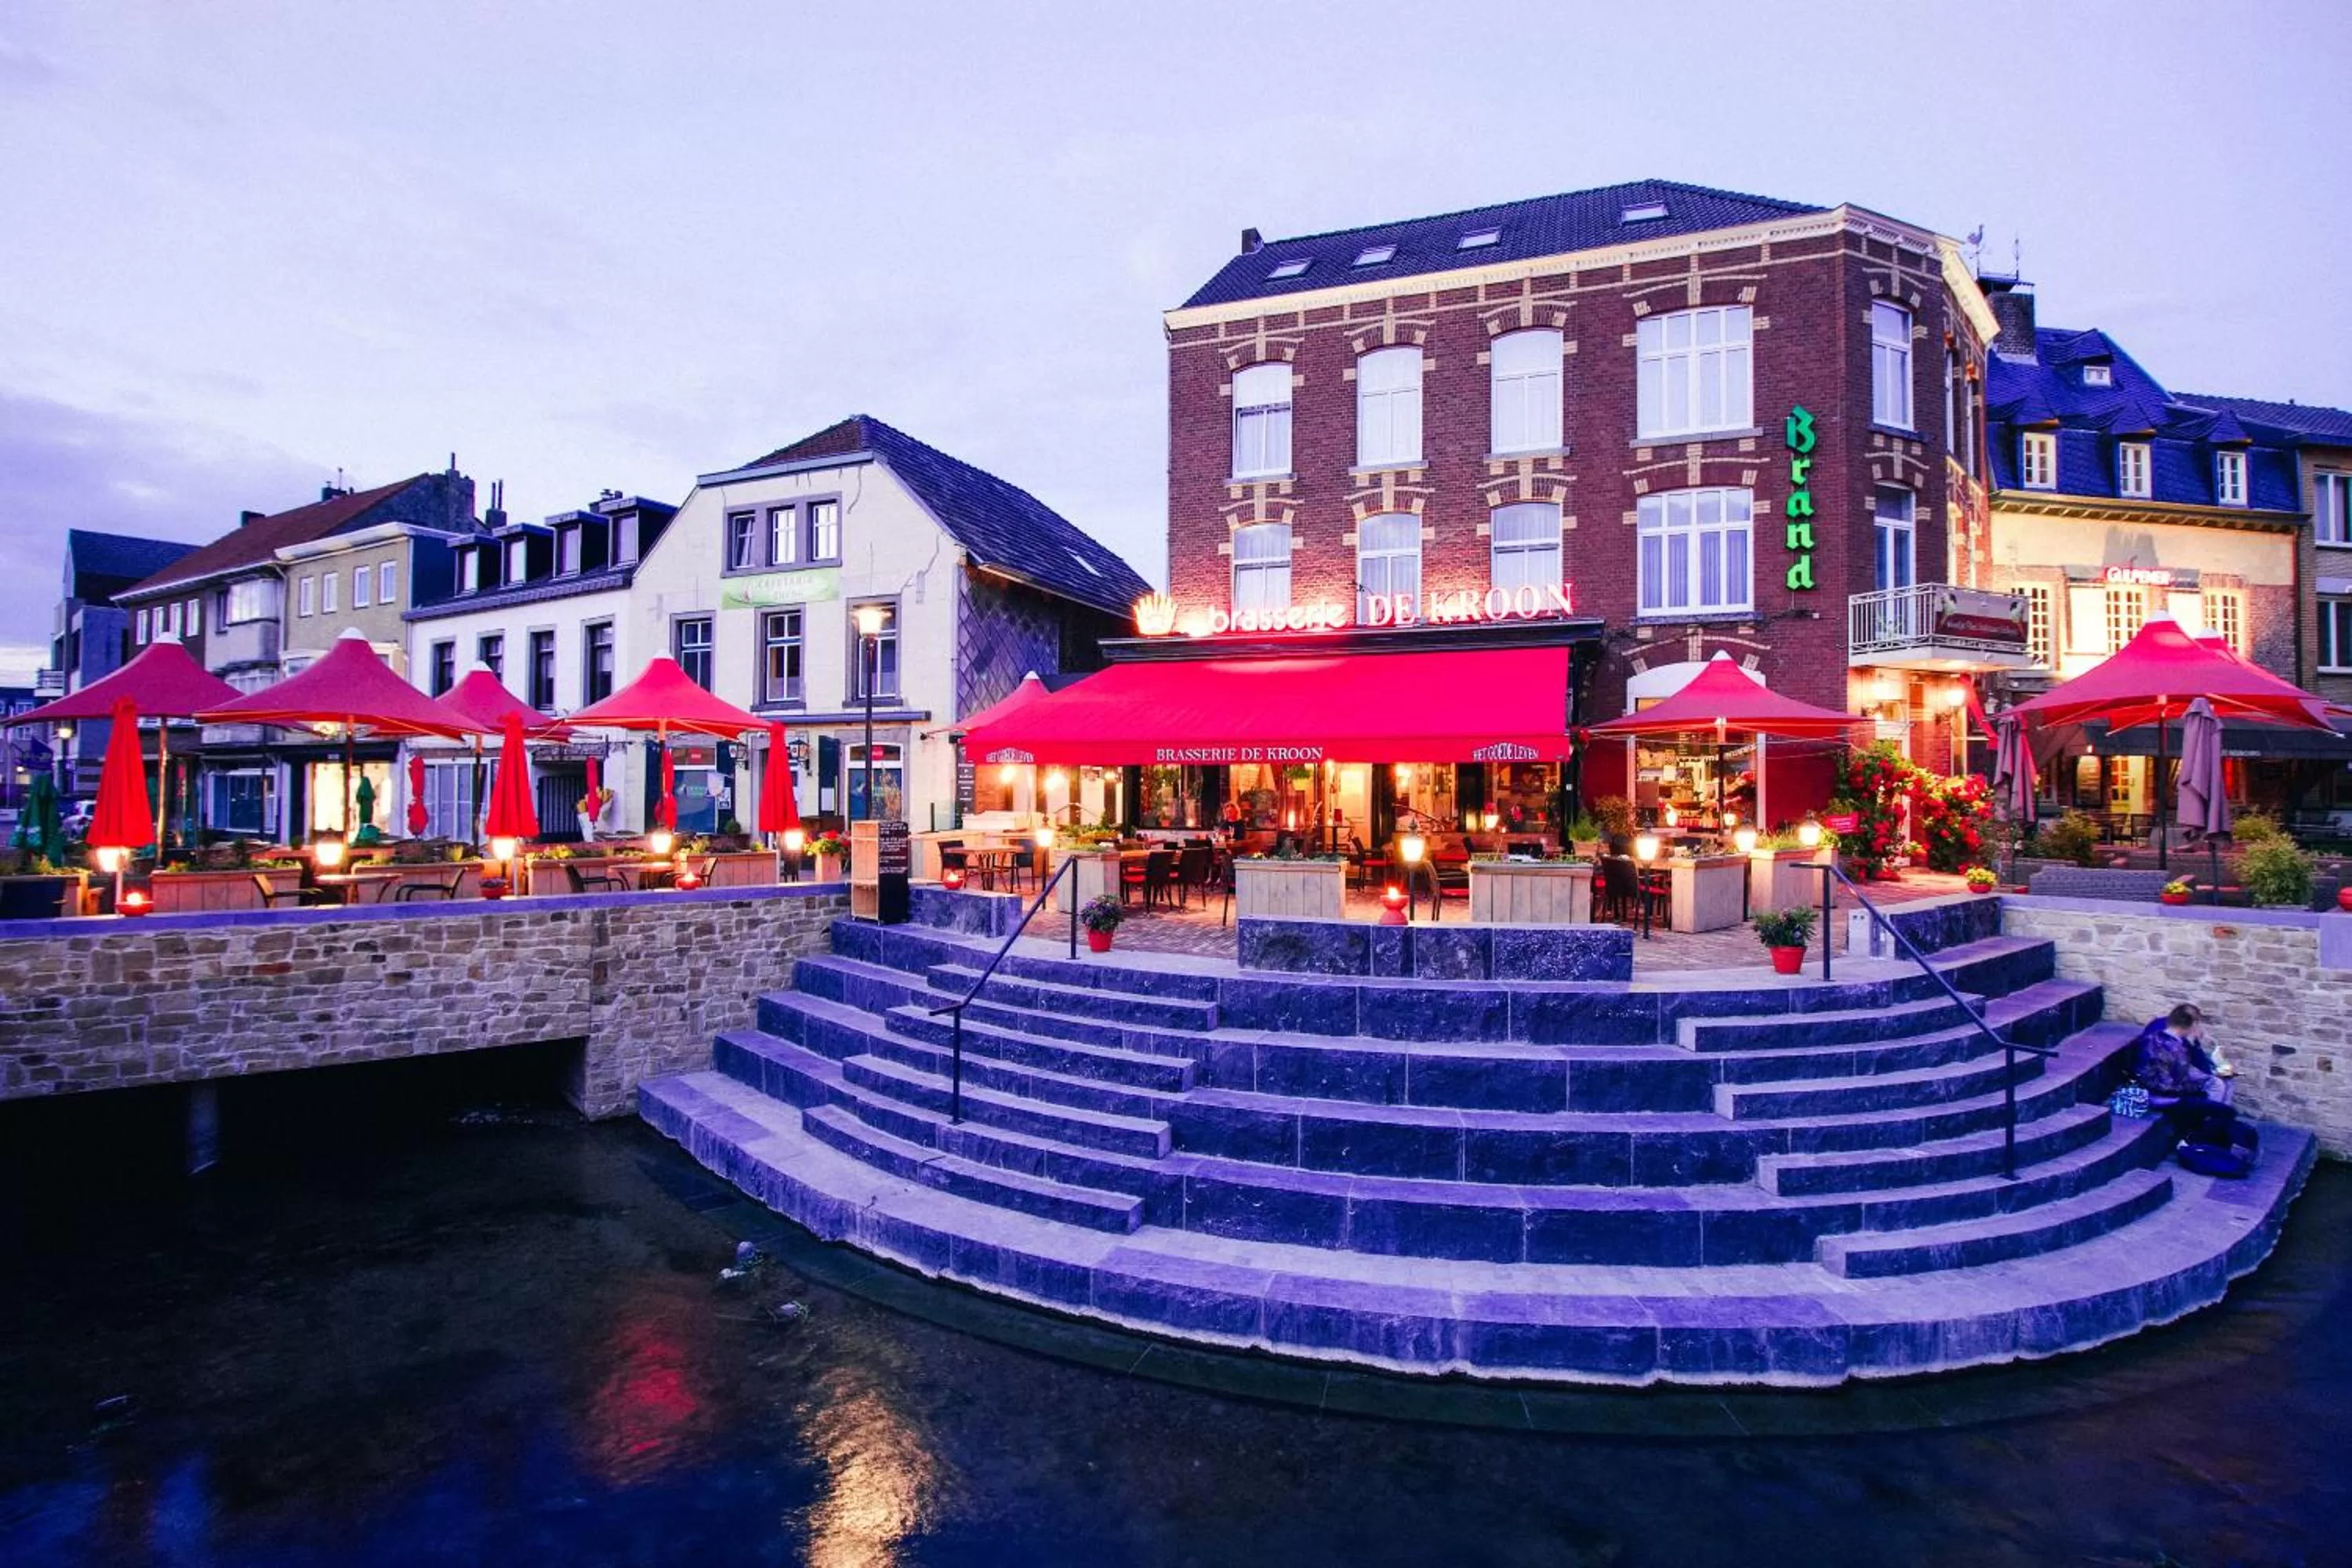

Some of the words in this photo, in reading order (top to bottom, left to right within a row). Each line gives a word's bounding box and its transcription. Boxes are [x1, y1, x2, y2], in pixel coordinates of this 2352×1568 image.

[1785, 405, 1816, 590] Brand
[1209, 599, 1346, 633] brasserie
[1367, 593, 1414, 626] DE
[1430, 583, 1574, 625] KROON
[1156, 748, 1236, 760] BRASSERIE
[1241, 748, 1262, 760] DE
[1267, 747, 1323, 760] KROON
